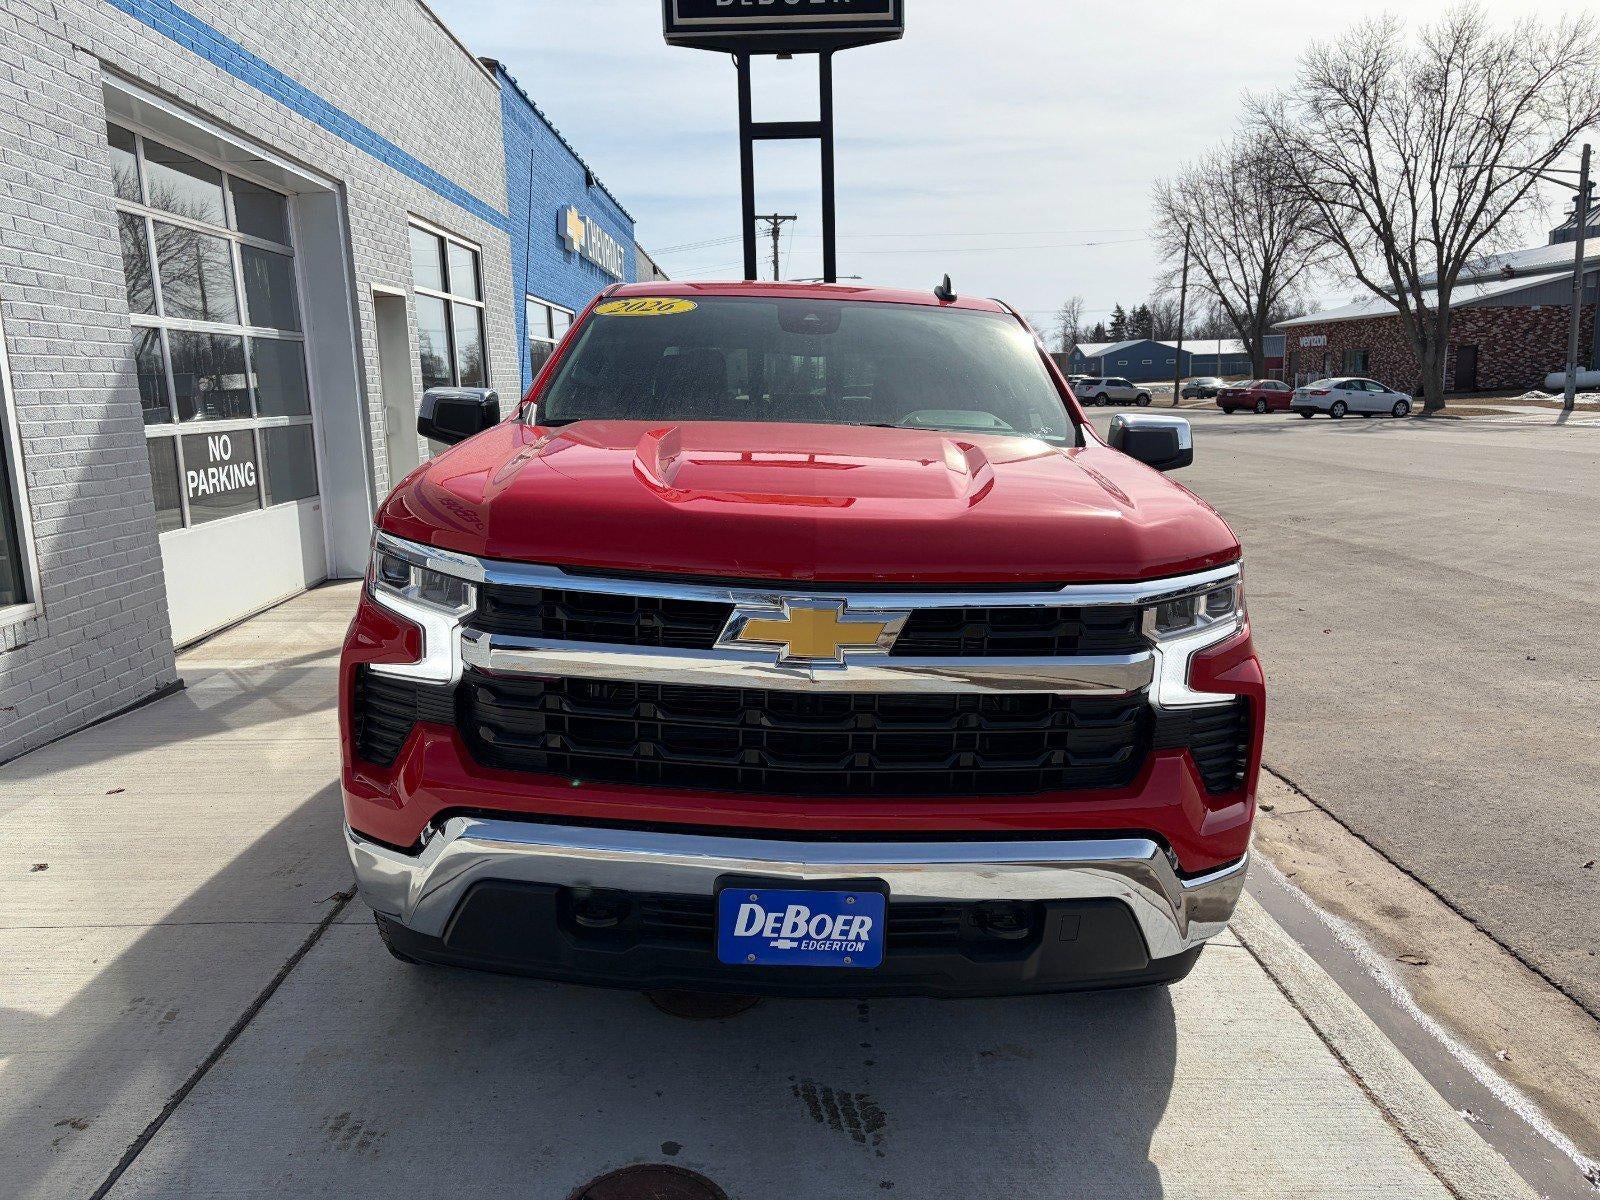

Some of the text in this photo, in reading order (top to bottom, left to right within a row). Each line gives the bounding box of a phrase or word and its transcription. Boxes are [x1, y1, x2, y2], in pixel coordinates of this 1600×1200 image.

[585, 215, 625, 281] CHEVROLET
[605, 301, 676, 314] 2026
[1299, 335, 1327, 347] verizon
[207, 434, 232, 462] NO
[186, 461, 256, 498] PARKING
[801, 940, 866, 952] EDGERTON
